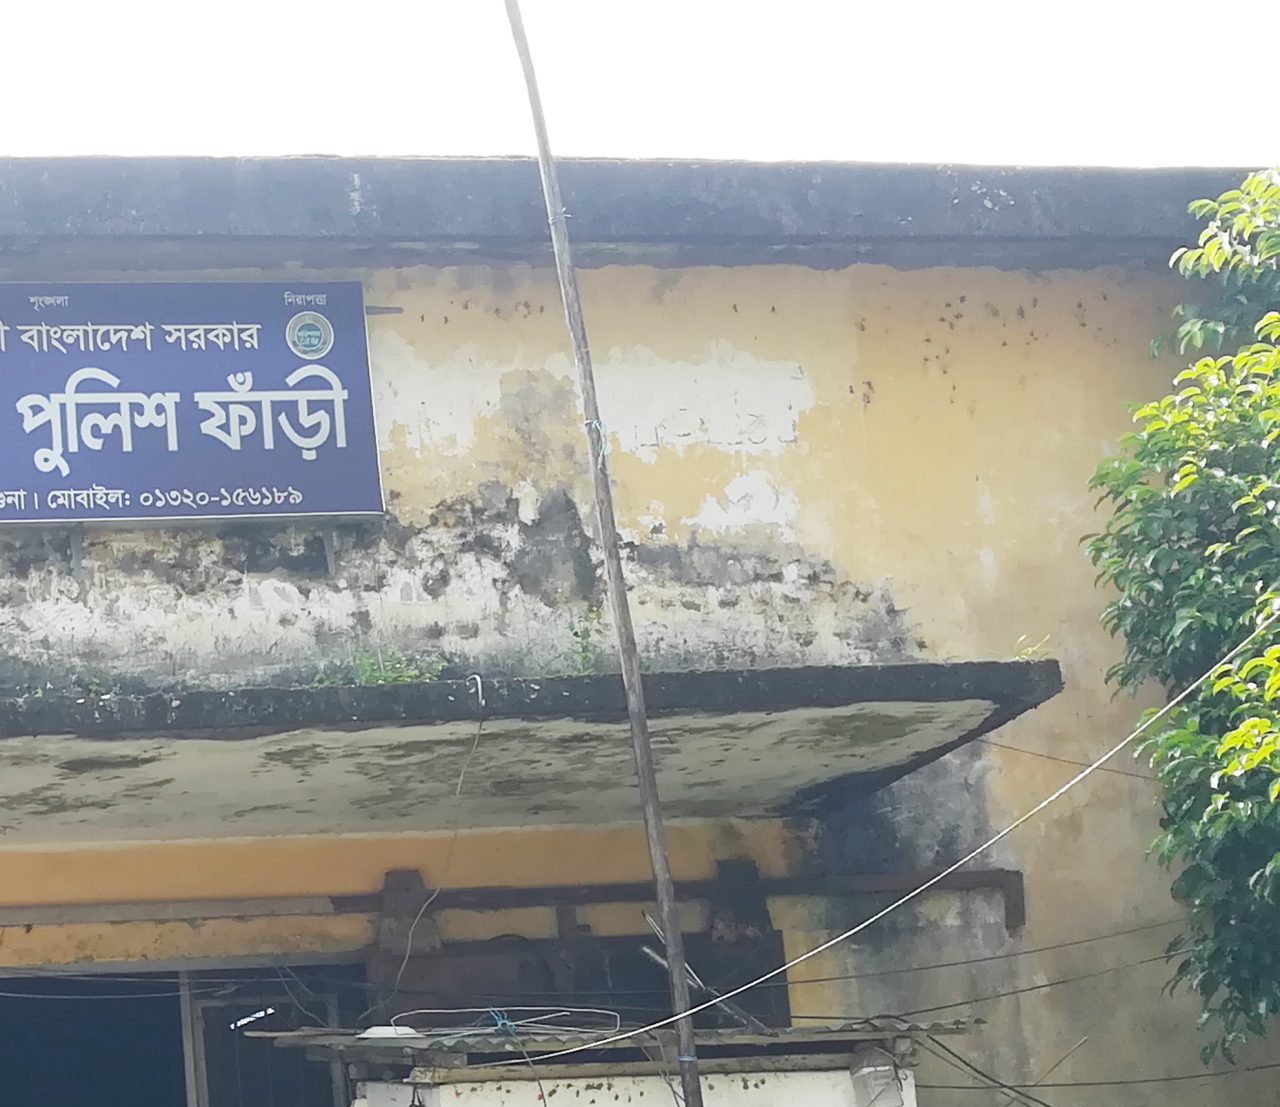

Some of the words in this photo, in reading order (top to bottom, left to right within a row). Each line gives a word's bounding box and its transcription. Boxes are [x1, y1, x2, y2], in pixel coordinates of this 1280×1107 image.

[16, 321, 155, 354] বাংলাদেশ
[161, 321, 262, 351] সরকার
[15, 367, 181, 477] পুলিশ
[193, 364, 348, 461] ফাঁড়ী
[139, 486, 303, 509] ০১৩২০-১৫৬১৮৯
